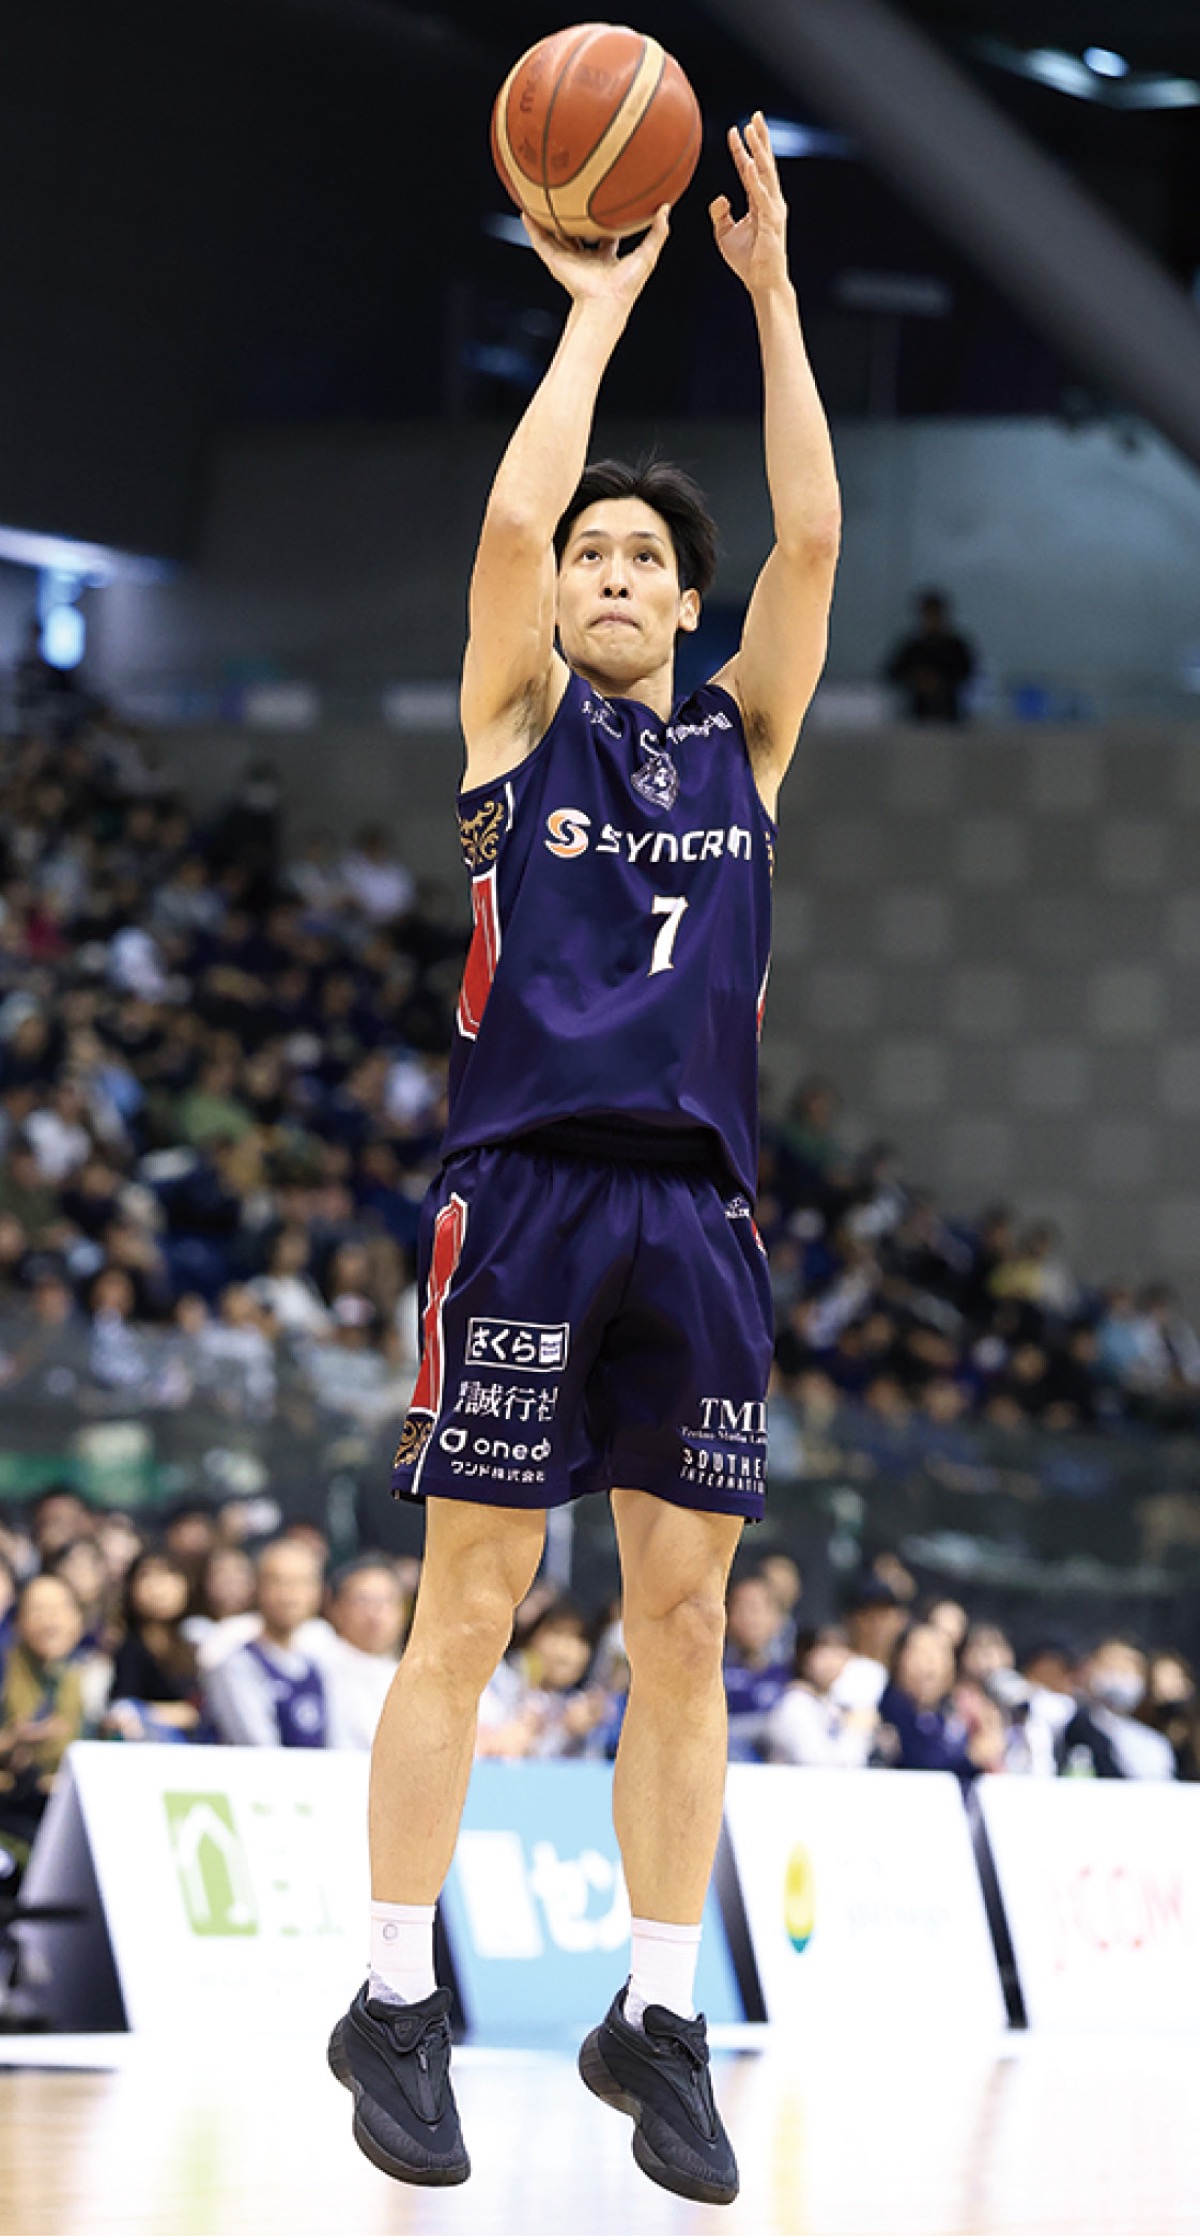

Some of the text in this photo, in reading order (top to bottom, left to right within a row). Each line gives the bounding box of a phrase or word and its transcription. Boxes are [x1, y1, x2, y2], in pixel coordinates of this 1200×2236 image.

[648, 895, 689, 977] 7
[472, 1327, 535, 1363] さくら
[682, 1446, 767, 1478] SOUTHE
